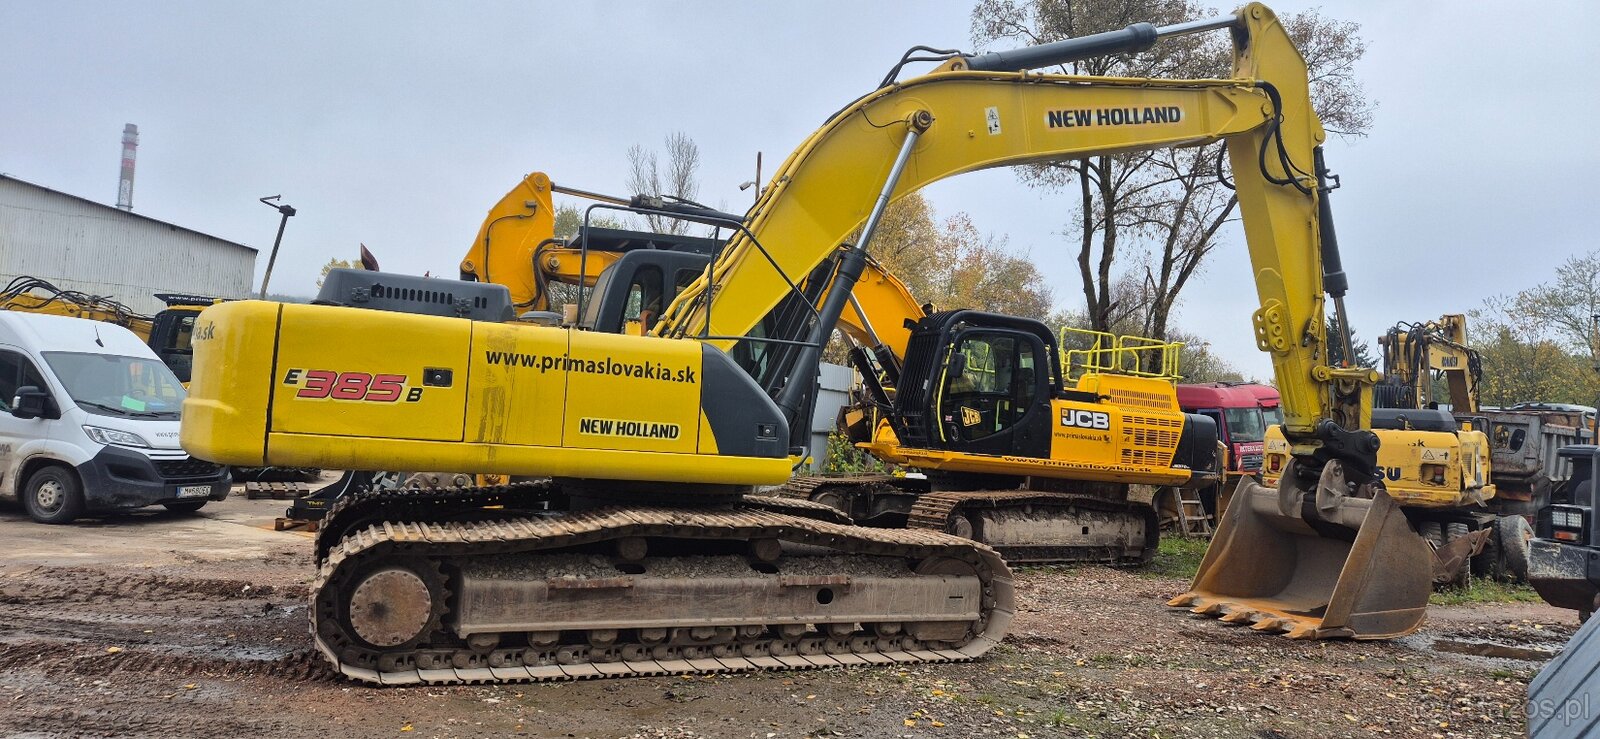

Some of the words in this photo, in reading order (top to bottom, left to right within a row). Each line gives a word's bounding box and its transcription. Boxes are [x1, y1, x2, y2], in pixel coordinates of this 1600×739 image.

[1048, 109, 1092, 128] NEW
[1097, 106, 1181, 126] HOLLAND
[486, 350, 697, 384] www.primaslovakia.sk
[580, 418, 613, 435] NEW
[615, 421, 680, 439] HOLLAND
[1062, 409, 1110, 430] JCB
